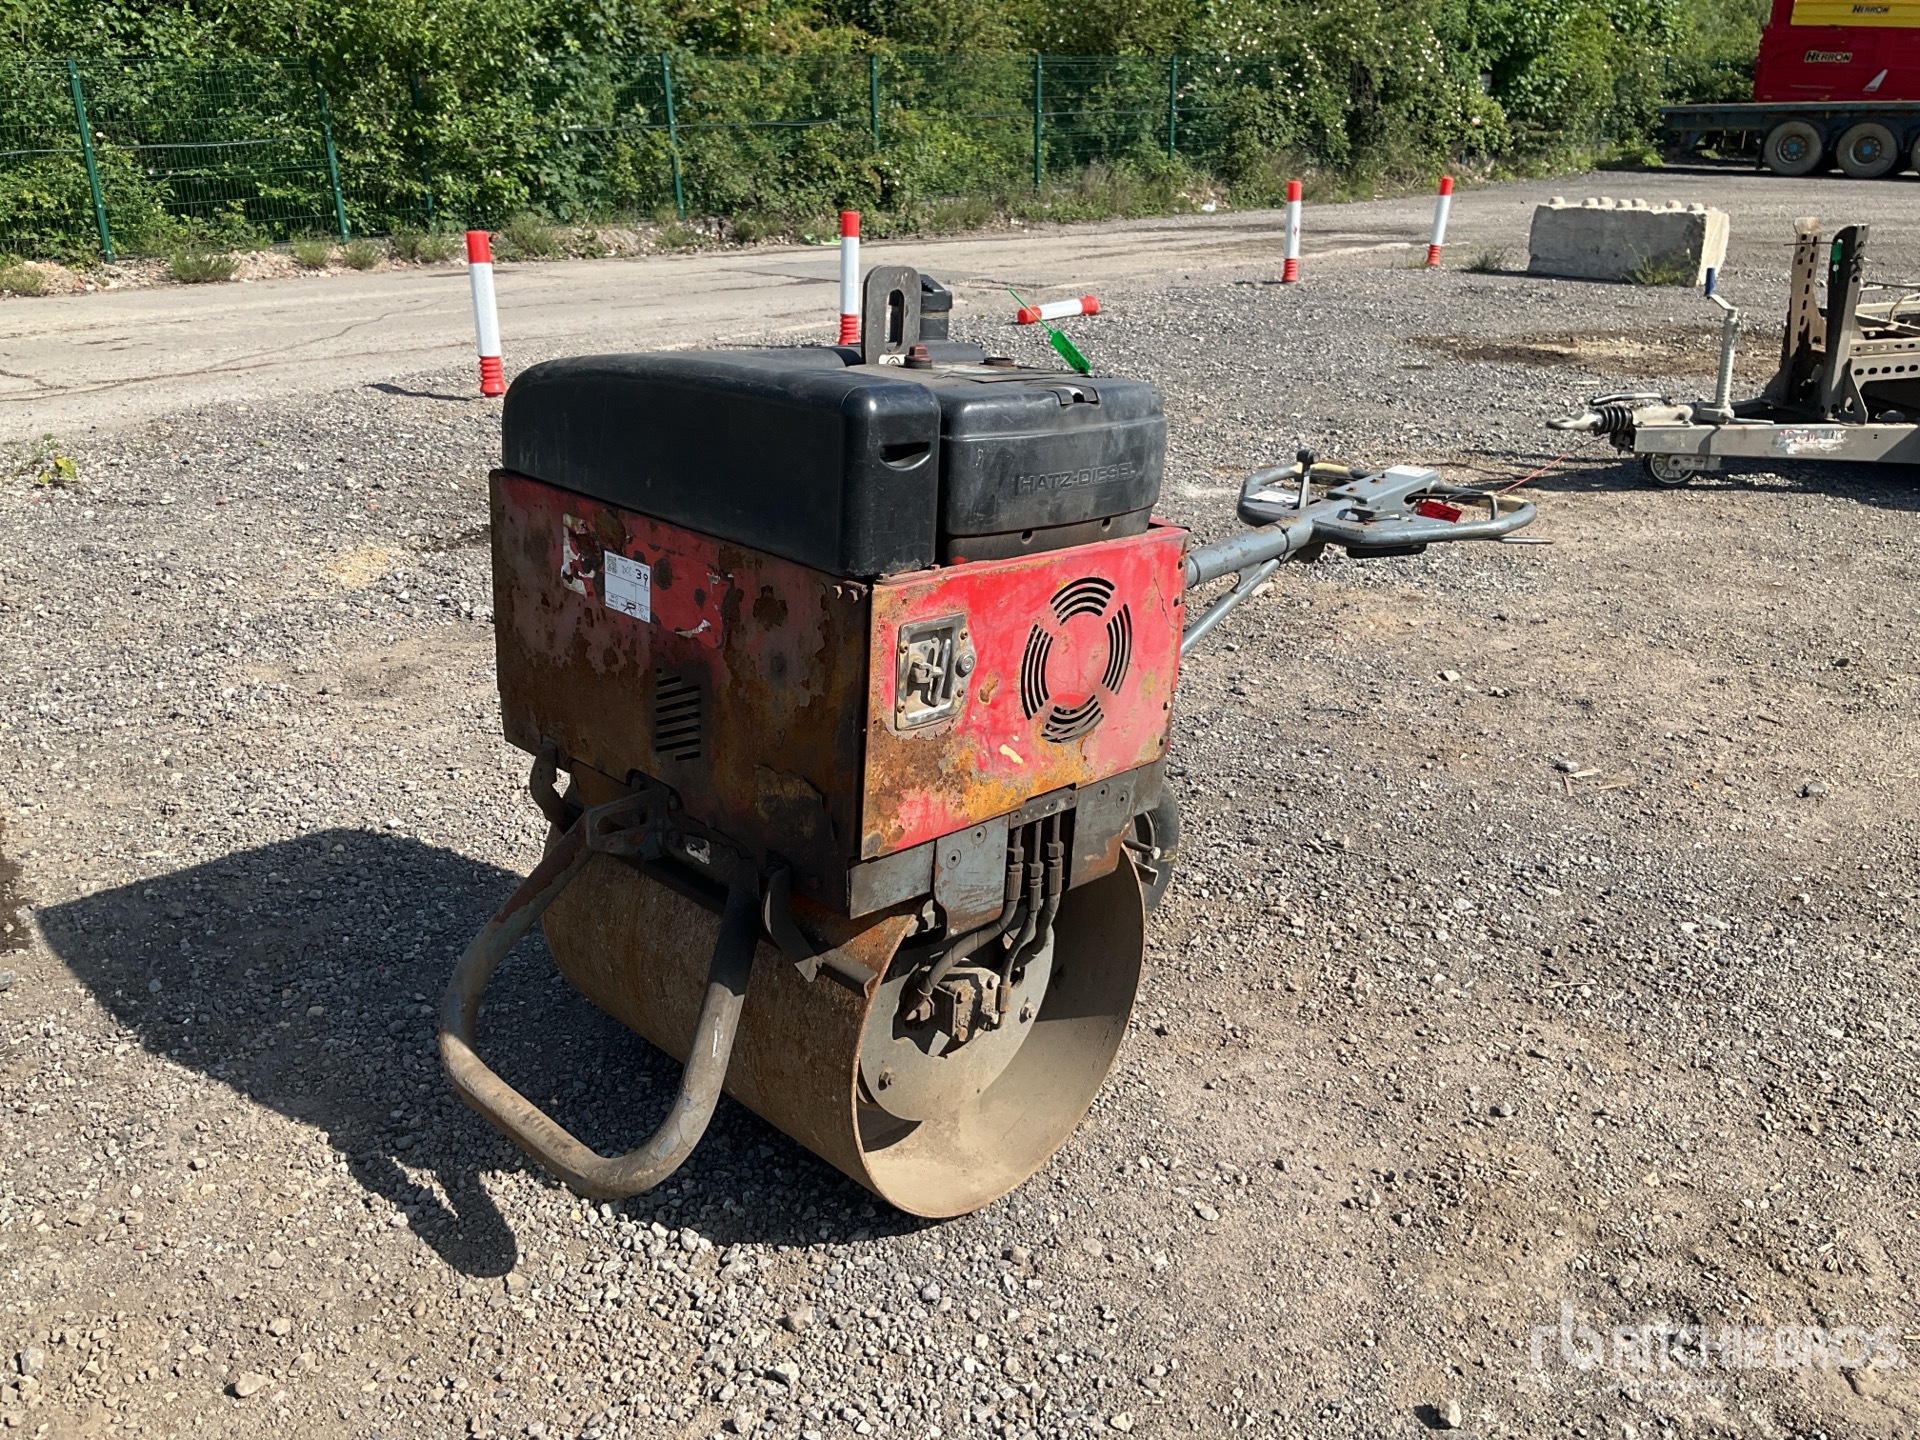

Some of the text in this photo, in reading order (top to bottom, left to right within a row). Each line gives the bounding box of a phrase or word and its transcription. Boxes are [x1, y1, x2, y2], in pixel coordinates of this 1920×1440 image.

[1852, 4, 1889, 13] HERRON
[1804, 50, 1853, 62] HERRON
[1018, 461, 1137, 492] HATZ-DIESEL
